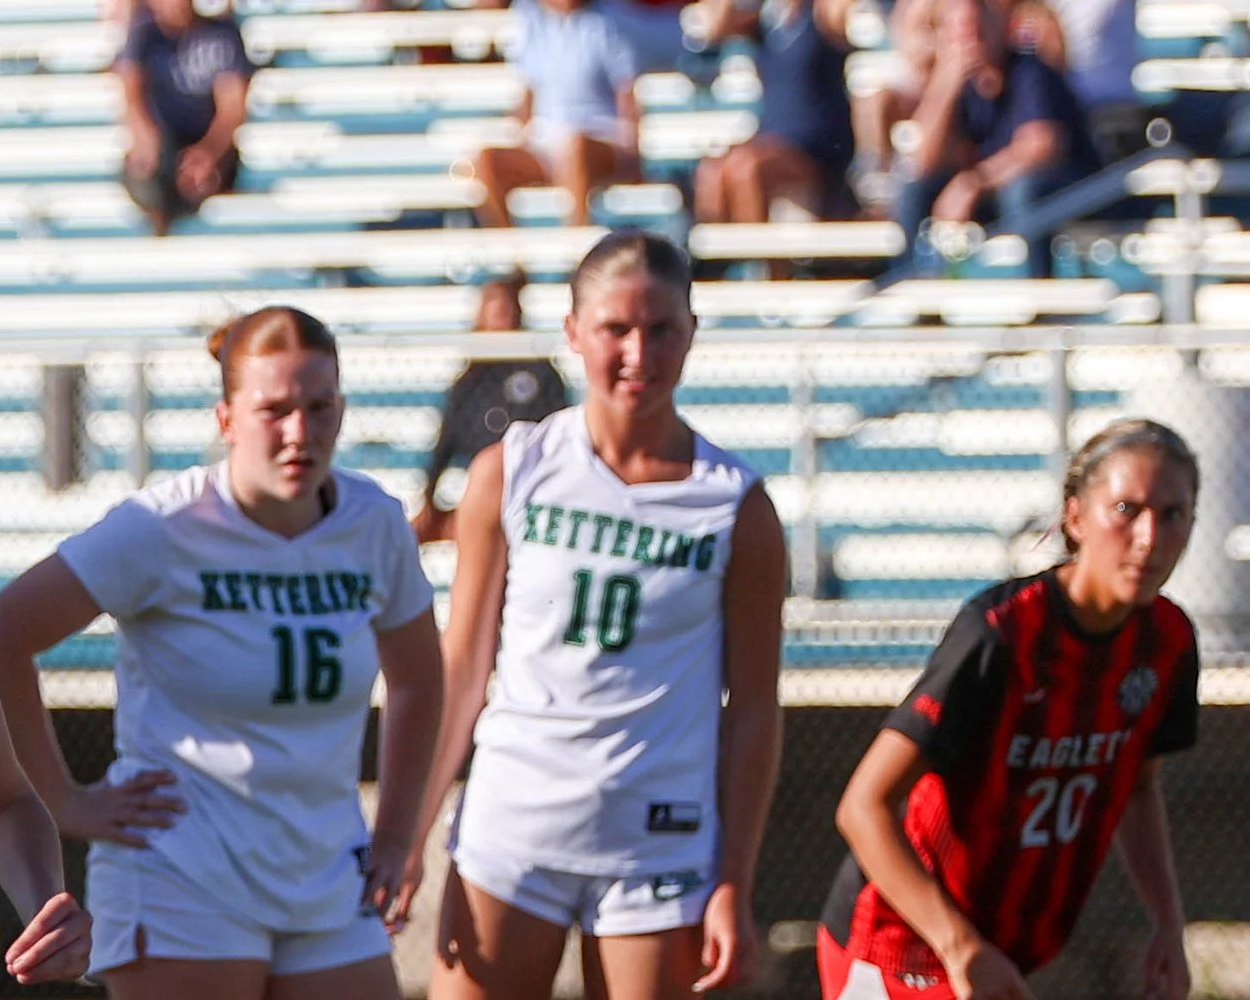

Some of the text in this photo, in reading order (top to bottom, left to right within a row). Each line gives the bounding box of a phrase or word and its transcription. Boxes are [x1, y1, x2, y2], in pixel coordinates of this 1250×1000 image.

[524, 504, 716, 571] KETTERING
[563, 569, 641, 652] 10
[270, 624, 342, 704] 16
[1007, 728, 1132, 769] EAGLET
[1020, 773, 1097, 847] 20
